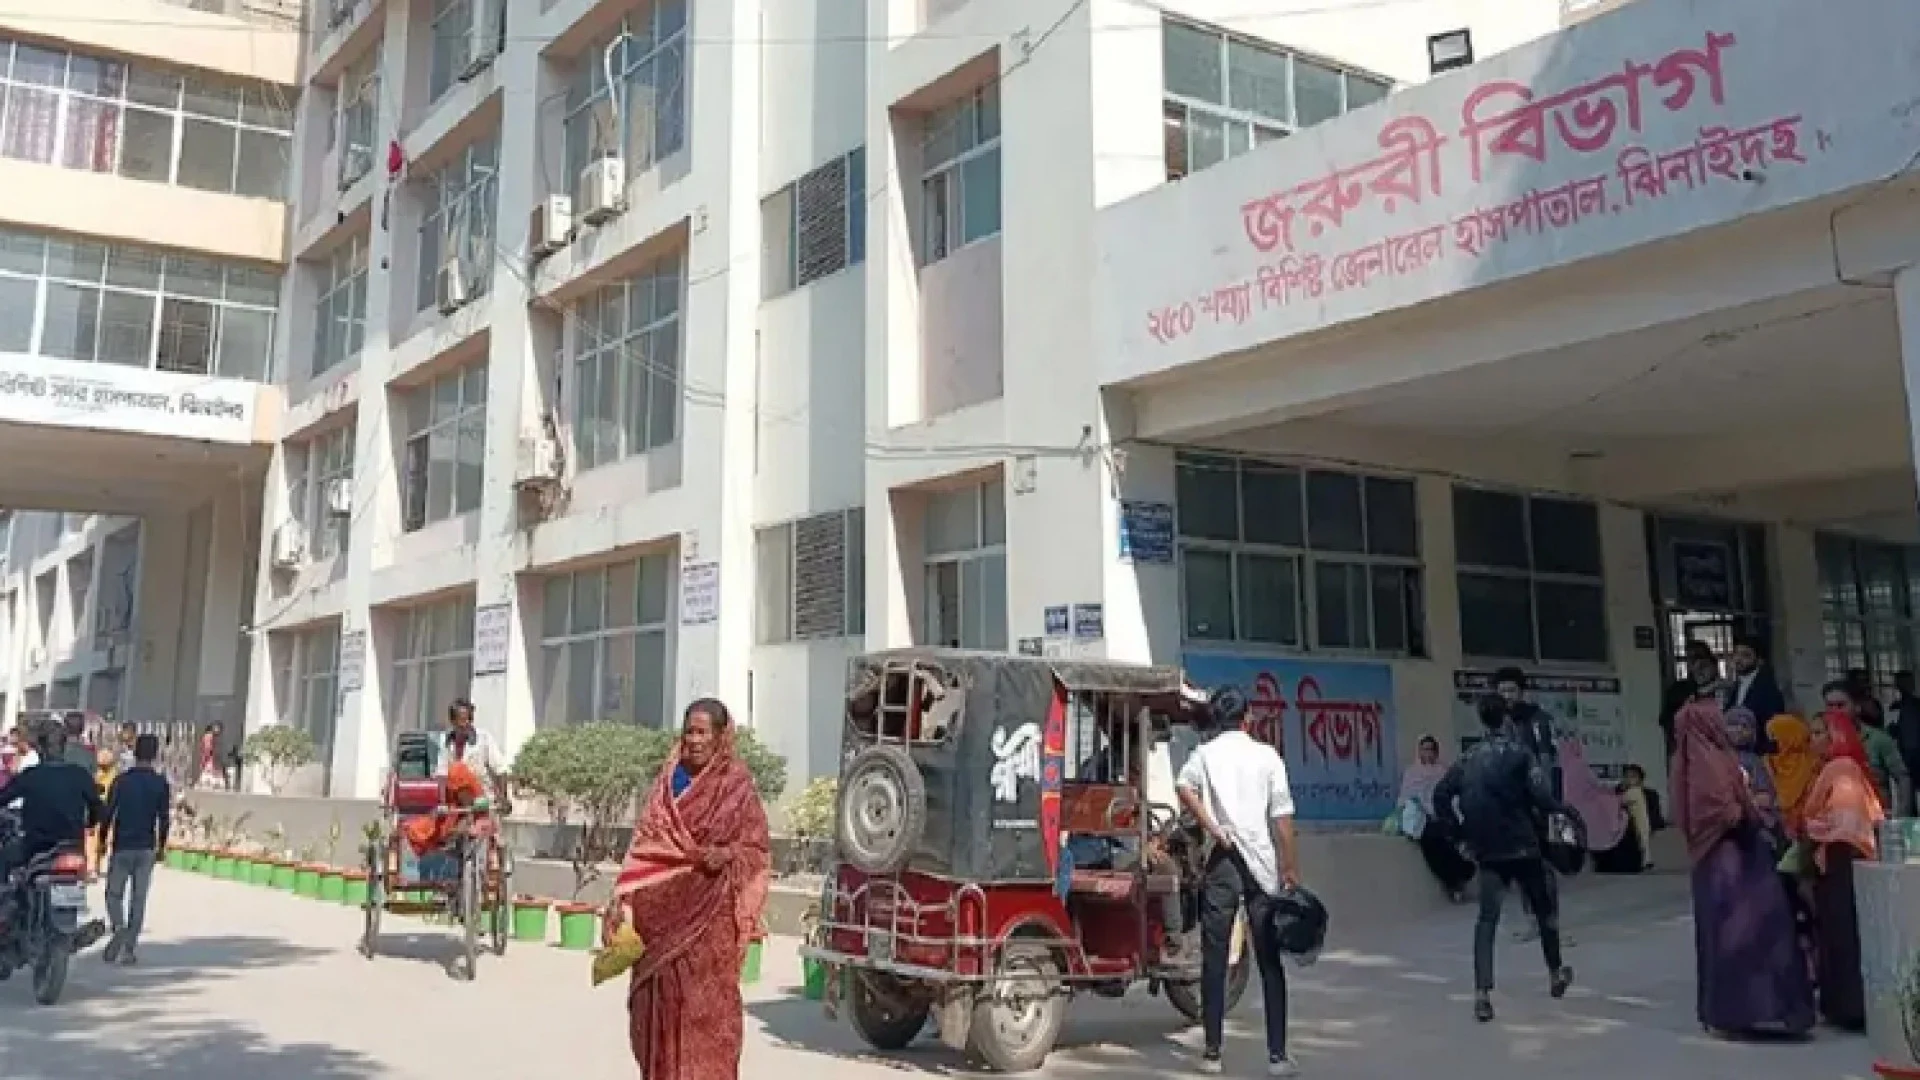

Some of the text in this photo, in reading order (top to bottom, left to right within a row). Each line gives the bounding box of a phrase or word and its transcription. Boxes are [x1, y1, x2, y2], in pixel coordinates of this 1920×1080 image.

[1146, 301, 1195, 345] ২৫০
[1257, 253, 1326, 310] বিশিষ্ট
[1331, 223, 1448, 291] জেনারেল
[1616, 115, 1806, 206] ঝিনাইদহ
[1240, 30, 1737, 252] জরুরী বিভাগ
[1295, 673, 1386, 770] বিভাগ
